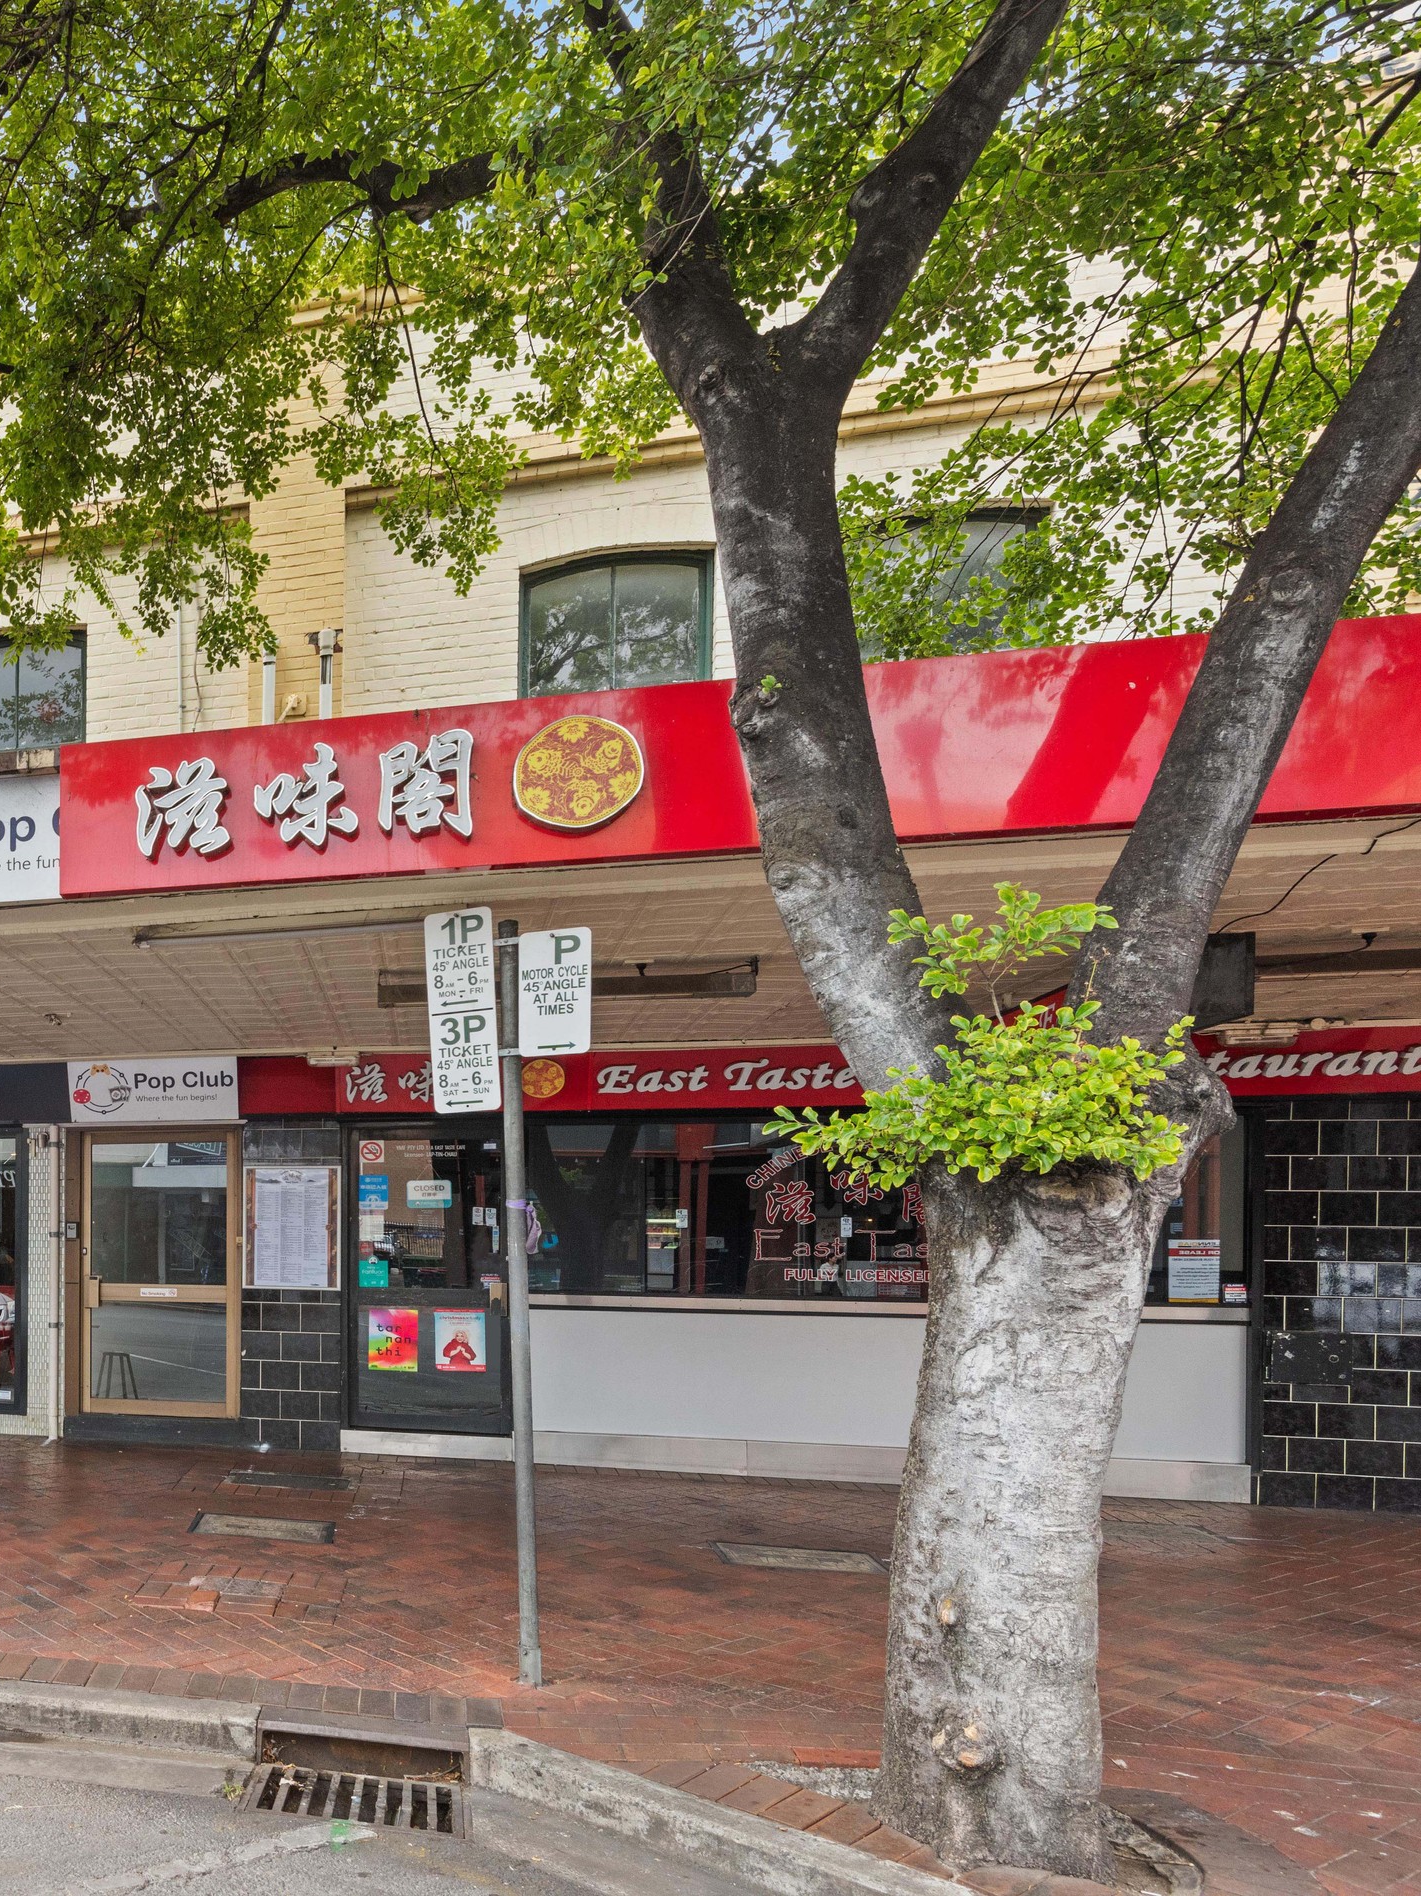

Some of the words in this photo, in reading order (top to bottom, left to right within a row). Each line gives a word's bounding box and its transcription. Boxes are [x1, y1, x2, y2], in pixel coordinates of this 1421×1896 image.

[6, 856, 31, 872] the
[440, 914, 484, 945] 1P
[432, 943, 486, 960] TICKET
[554, 934, 581, 965] P
[452, 956, 489, 970] ANGLE
[521, 967, 554, 981] MOTOR
[558, 964, 588, 978] CYCLE
[438, 990, 456, 998] MON
[469, 986, 484, 994] FRI
[533, 993, 549, 1005] AT
[554, 991, 579, 1003] ALL
[537, 1003, 575, 1016] TIMES
[440, 1014, 486, 1045] 3P
[438, 1043, 491, 1058] TICKET
[456, 1056, 493, 1069] ANGLE
[1205, 1044, 1421, 1079] taurant
[134, 1073, 175, 1092] Pop
[182, 1070, 234, 1088] Club
[596, 1063, 709, 1095] East
[723, 1057, 859, 1092] Taste
[190, 1093, 218, 1102] begins!
[443, 1089, 459, 1097] SAT
[473, 1087, 490, 1095] SUN
[746, 1144, 834, 1189] CHINE
[753, 1228, 847, 1262] East
[854, 1228, 930, 1263] Tas
[784, 1269, 837, 1282] FULLY
[377, 1324, 402, 1332] tar
[376, 1347, 402, 1356] thi
